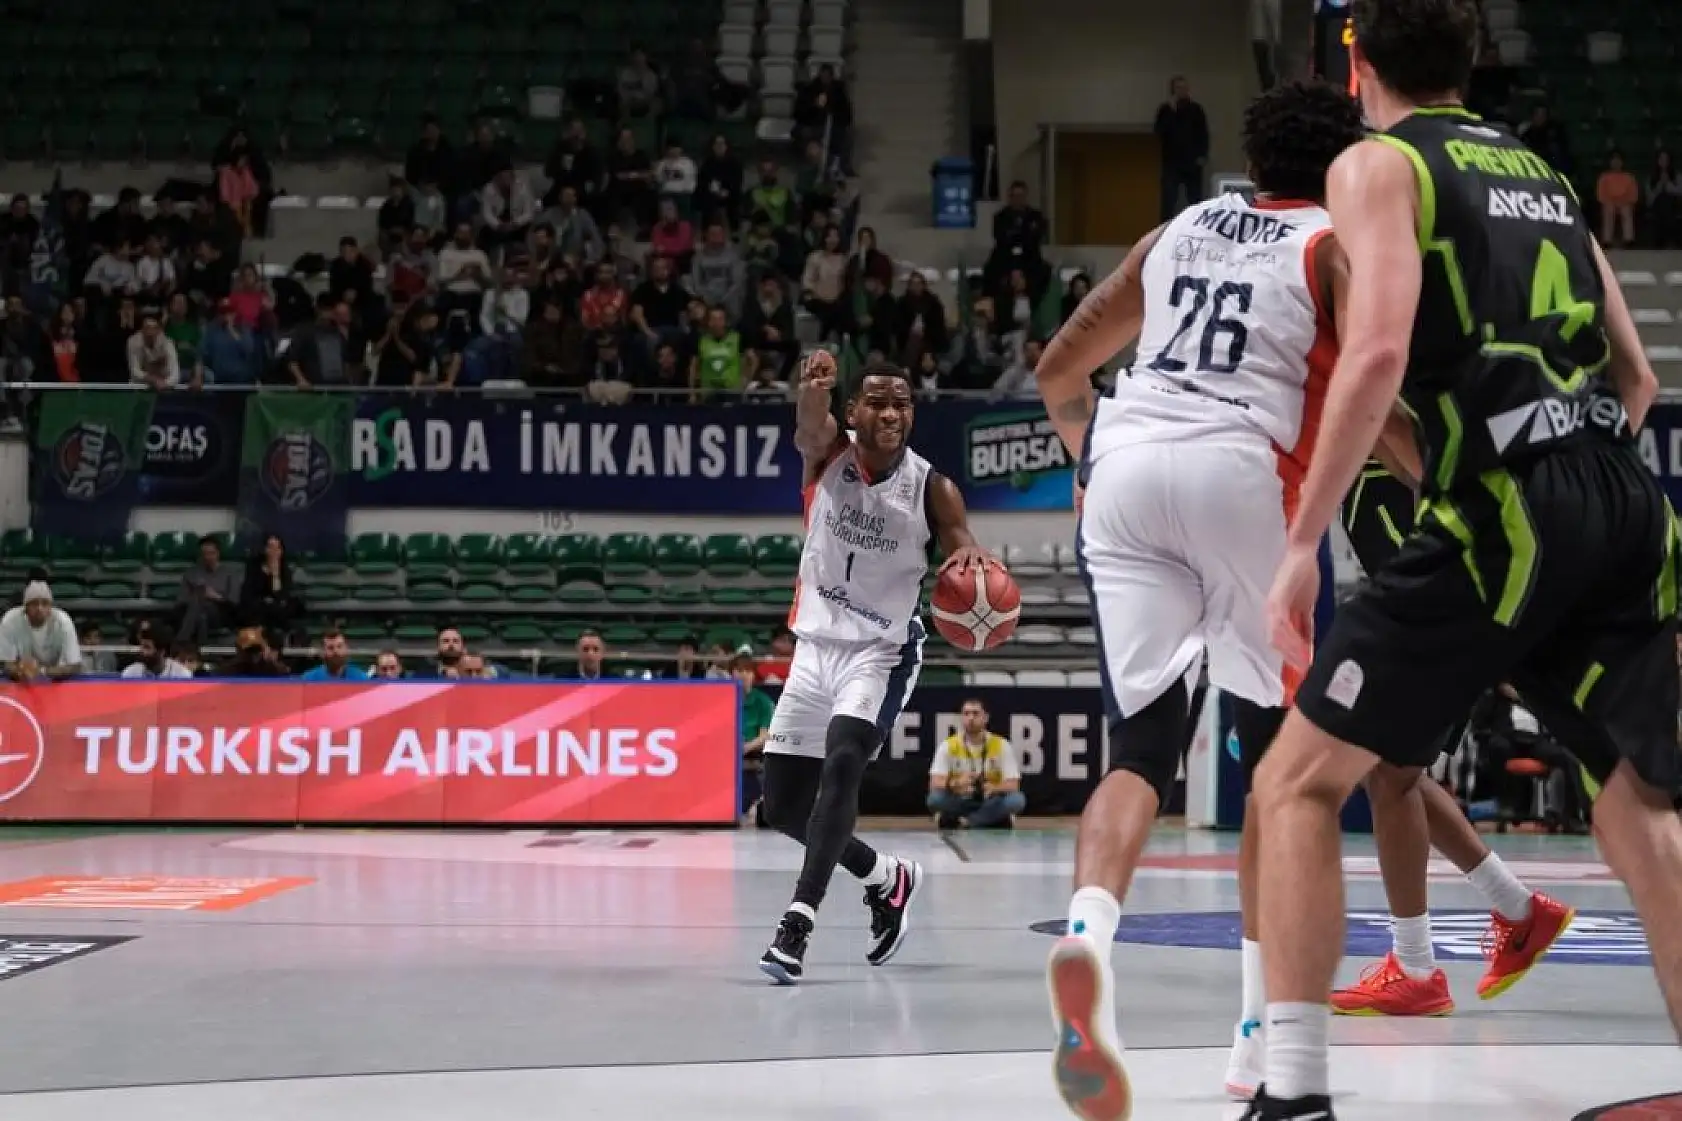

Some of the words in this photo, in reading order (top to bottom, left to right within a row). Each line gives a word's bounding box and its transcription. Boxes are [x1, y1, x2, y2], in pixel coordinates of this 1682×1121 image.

[1488, 186, 1575, 225] AYGAZ
[1530, 239, 1595, 342] 4
[1147, 275, 1254, 374] 26
[144, 425, 208, 461] OFAŞ
[519, 410, 782, 478] İMKANSIZ
[971, 435, 1067, 478] BURSA
[845, 551, 856, 582] 1
[75, 726, 362, 775] TURKISH
[383, 727, 679, 777] AIRLINES
